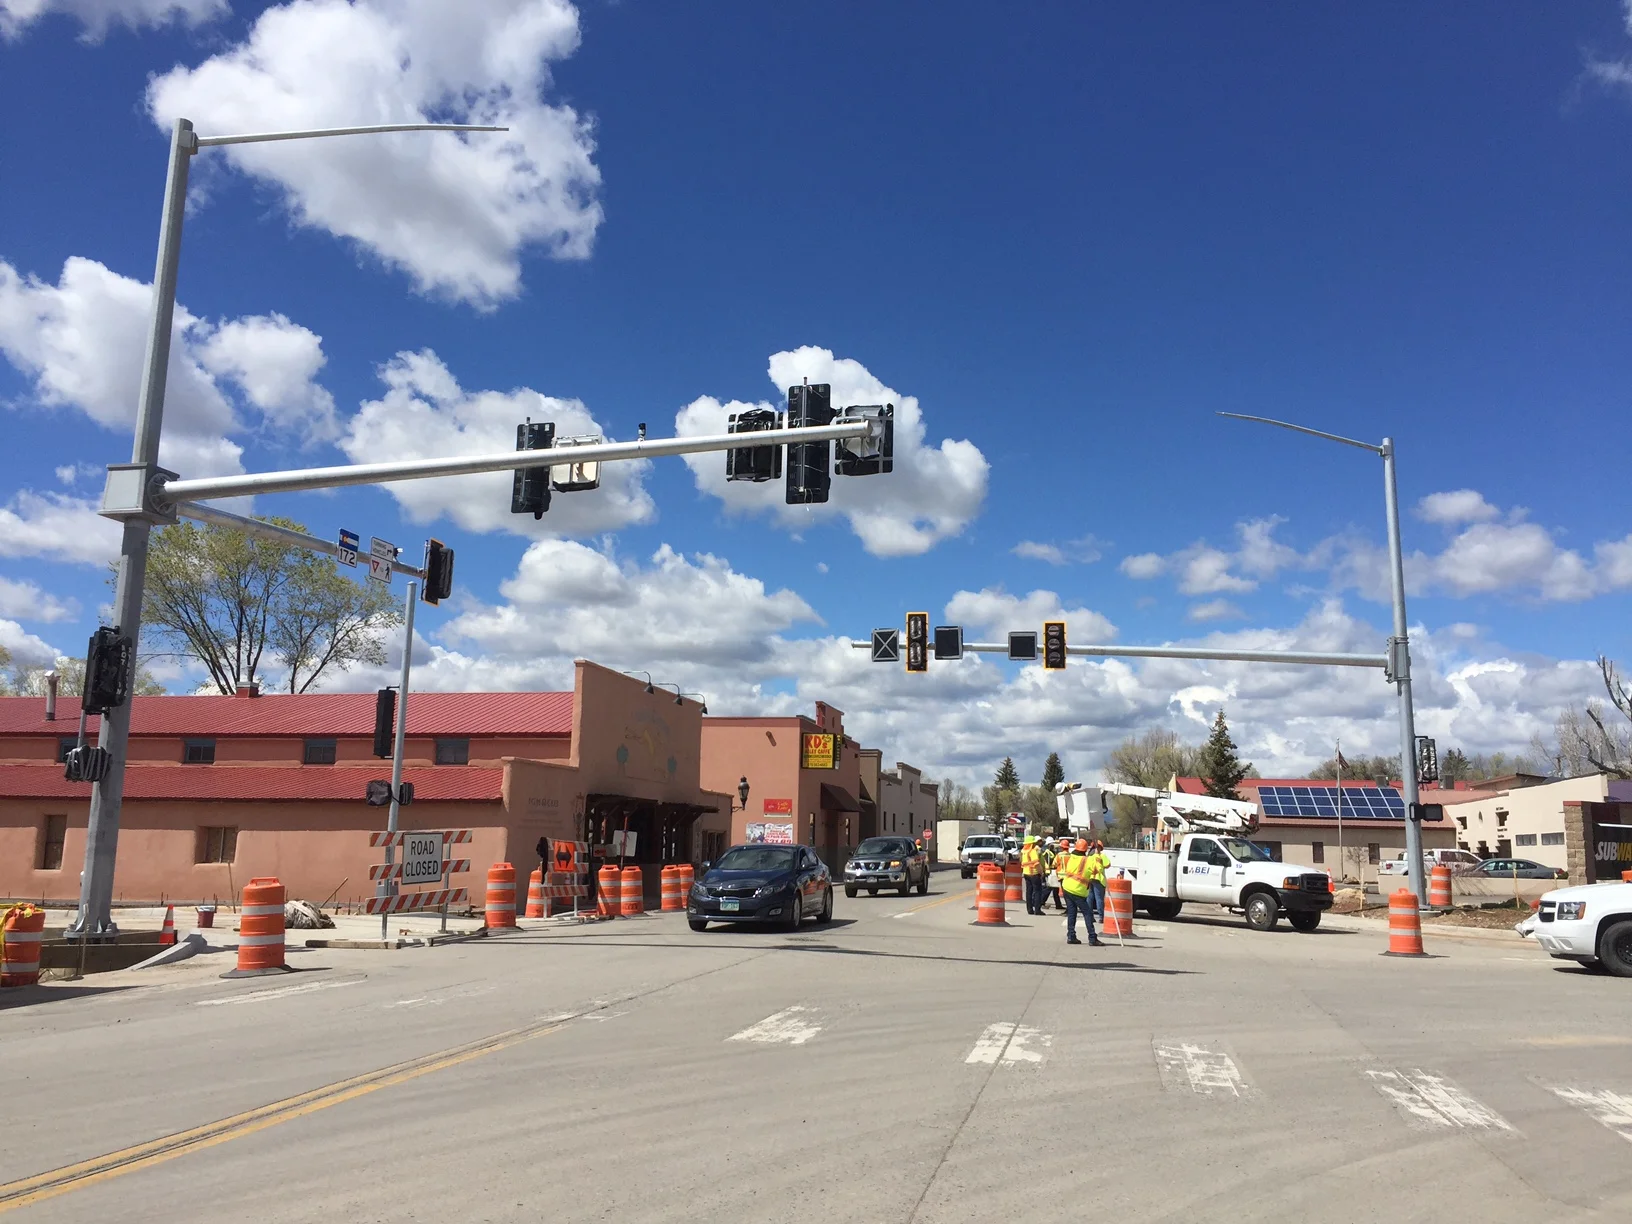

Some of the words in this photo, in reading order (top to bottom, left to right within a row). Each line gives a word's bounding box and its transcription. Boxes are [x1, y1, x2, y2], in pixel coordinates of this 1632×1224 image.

[340, 548, 356, 565] 172
[410, 840, 435, 856] ROAD
[405, 860, 439, 877] CLOSED
